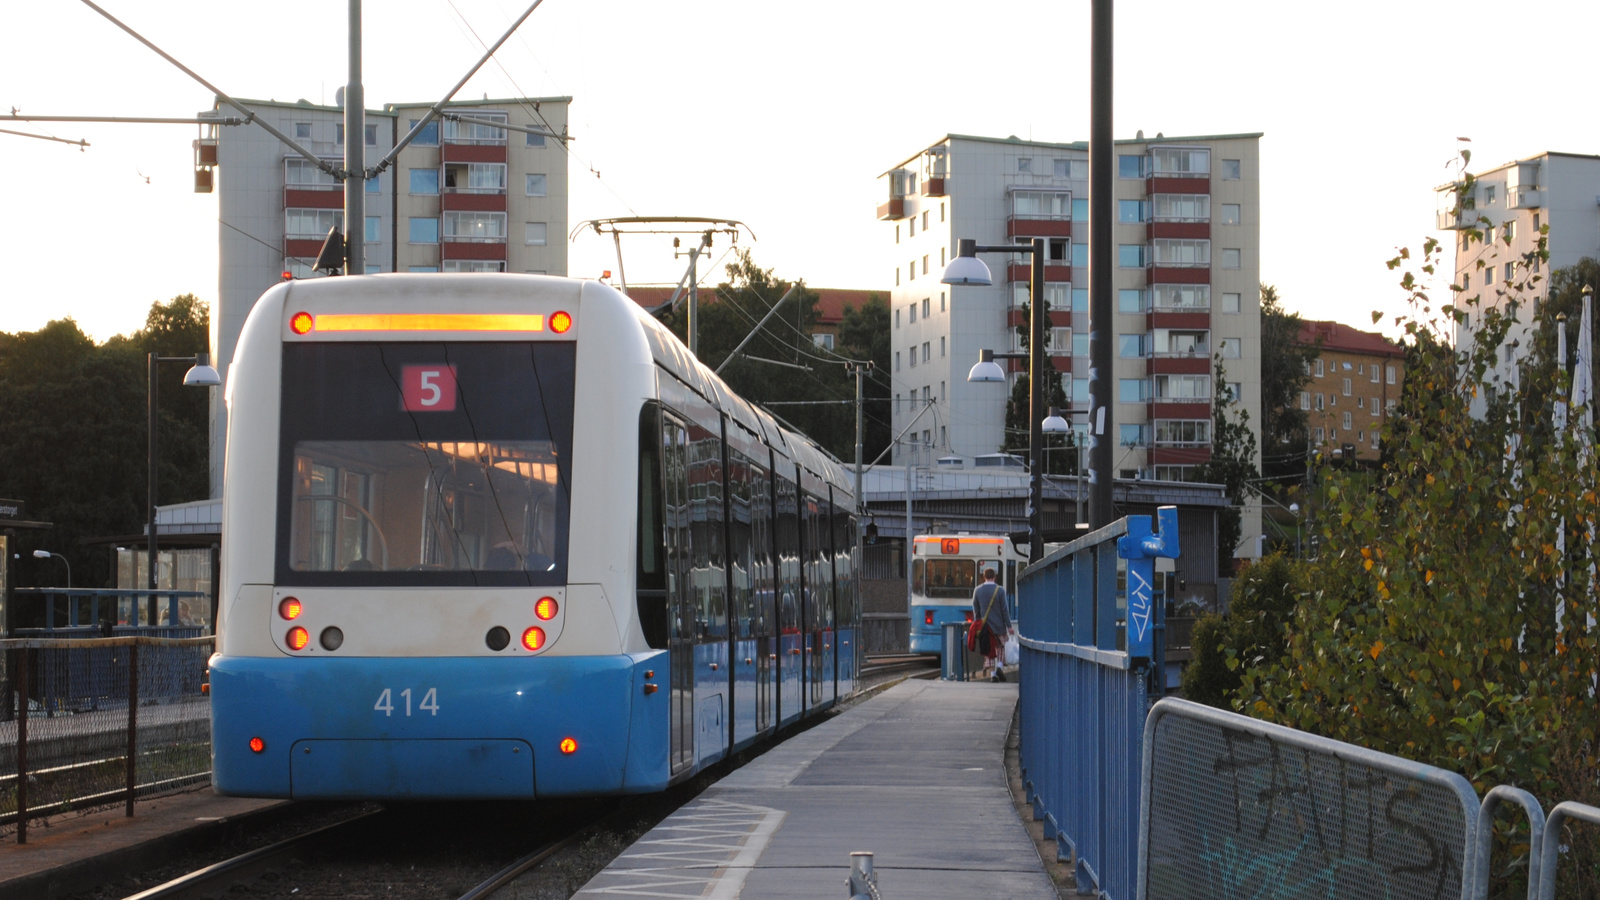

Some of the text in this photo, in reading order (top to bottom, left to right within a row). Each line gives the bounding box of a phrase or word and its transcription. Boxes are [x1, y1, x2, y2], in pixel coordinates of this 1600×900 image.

[421, 371, 441, 406] 5
[946, 540, 955, 553] 6
[374, 688, 440, 717] 414
